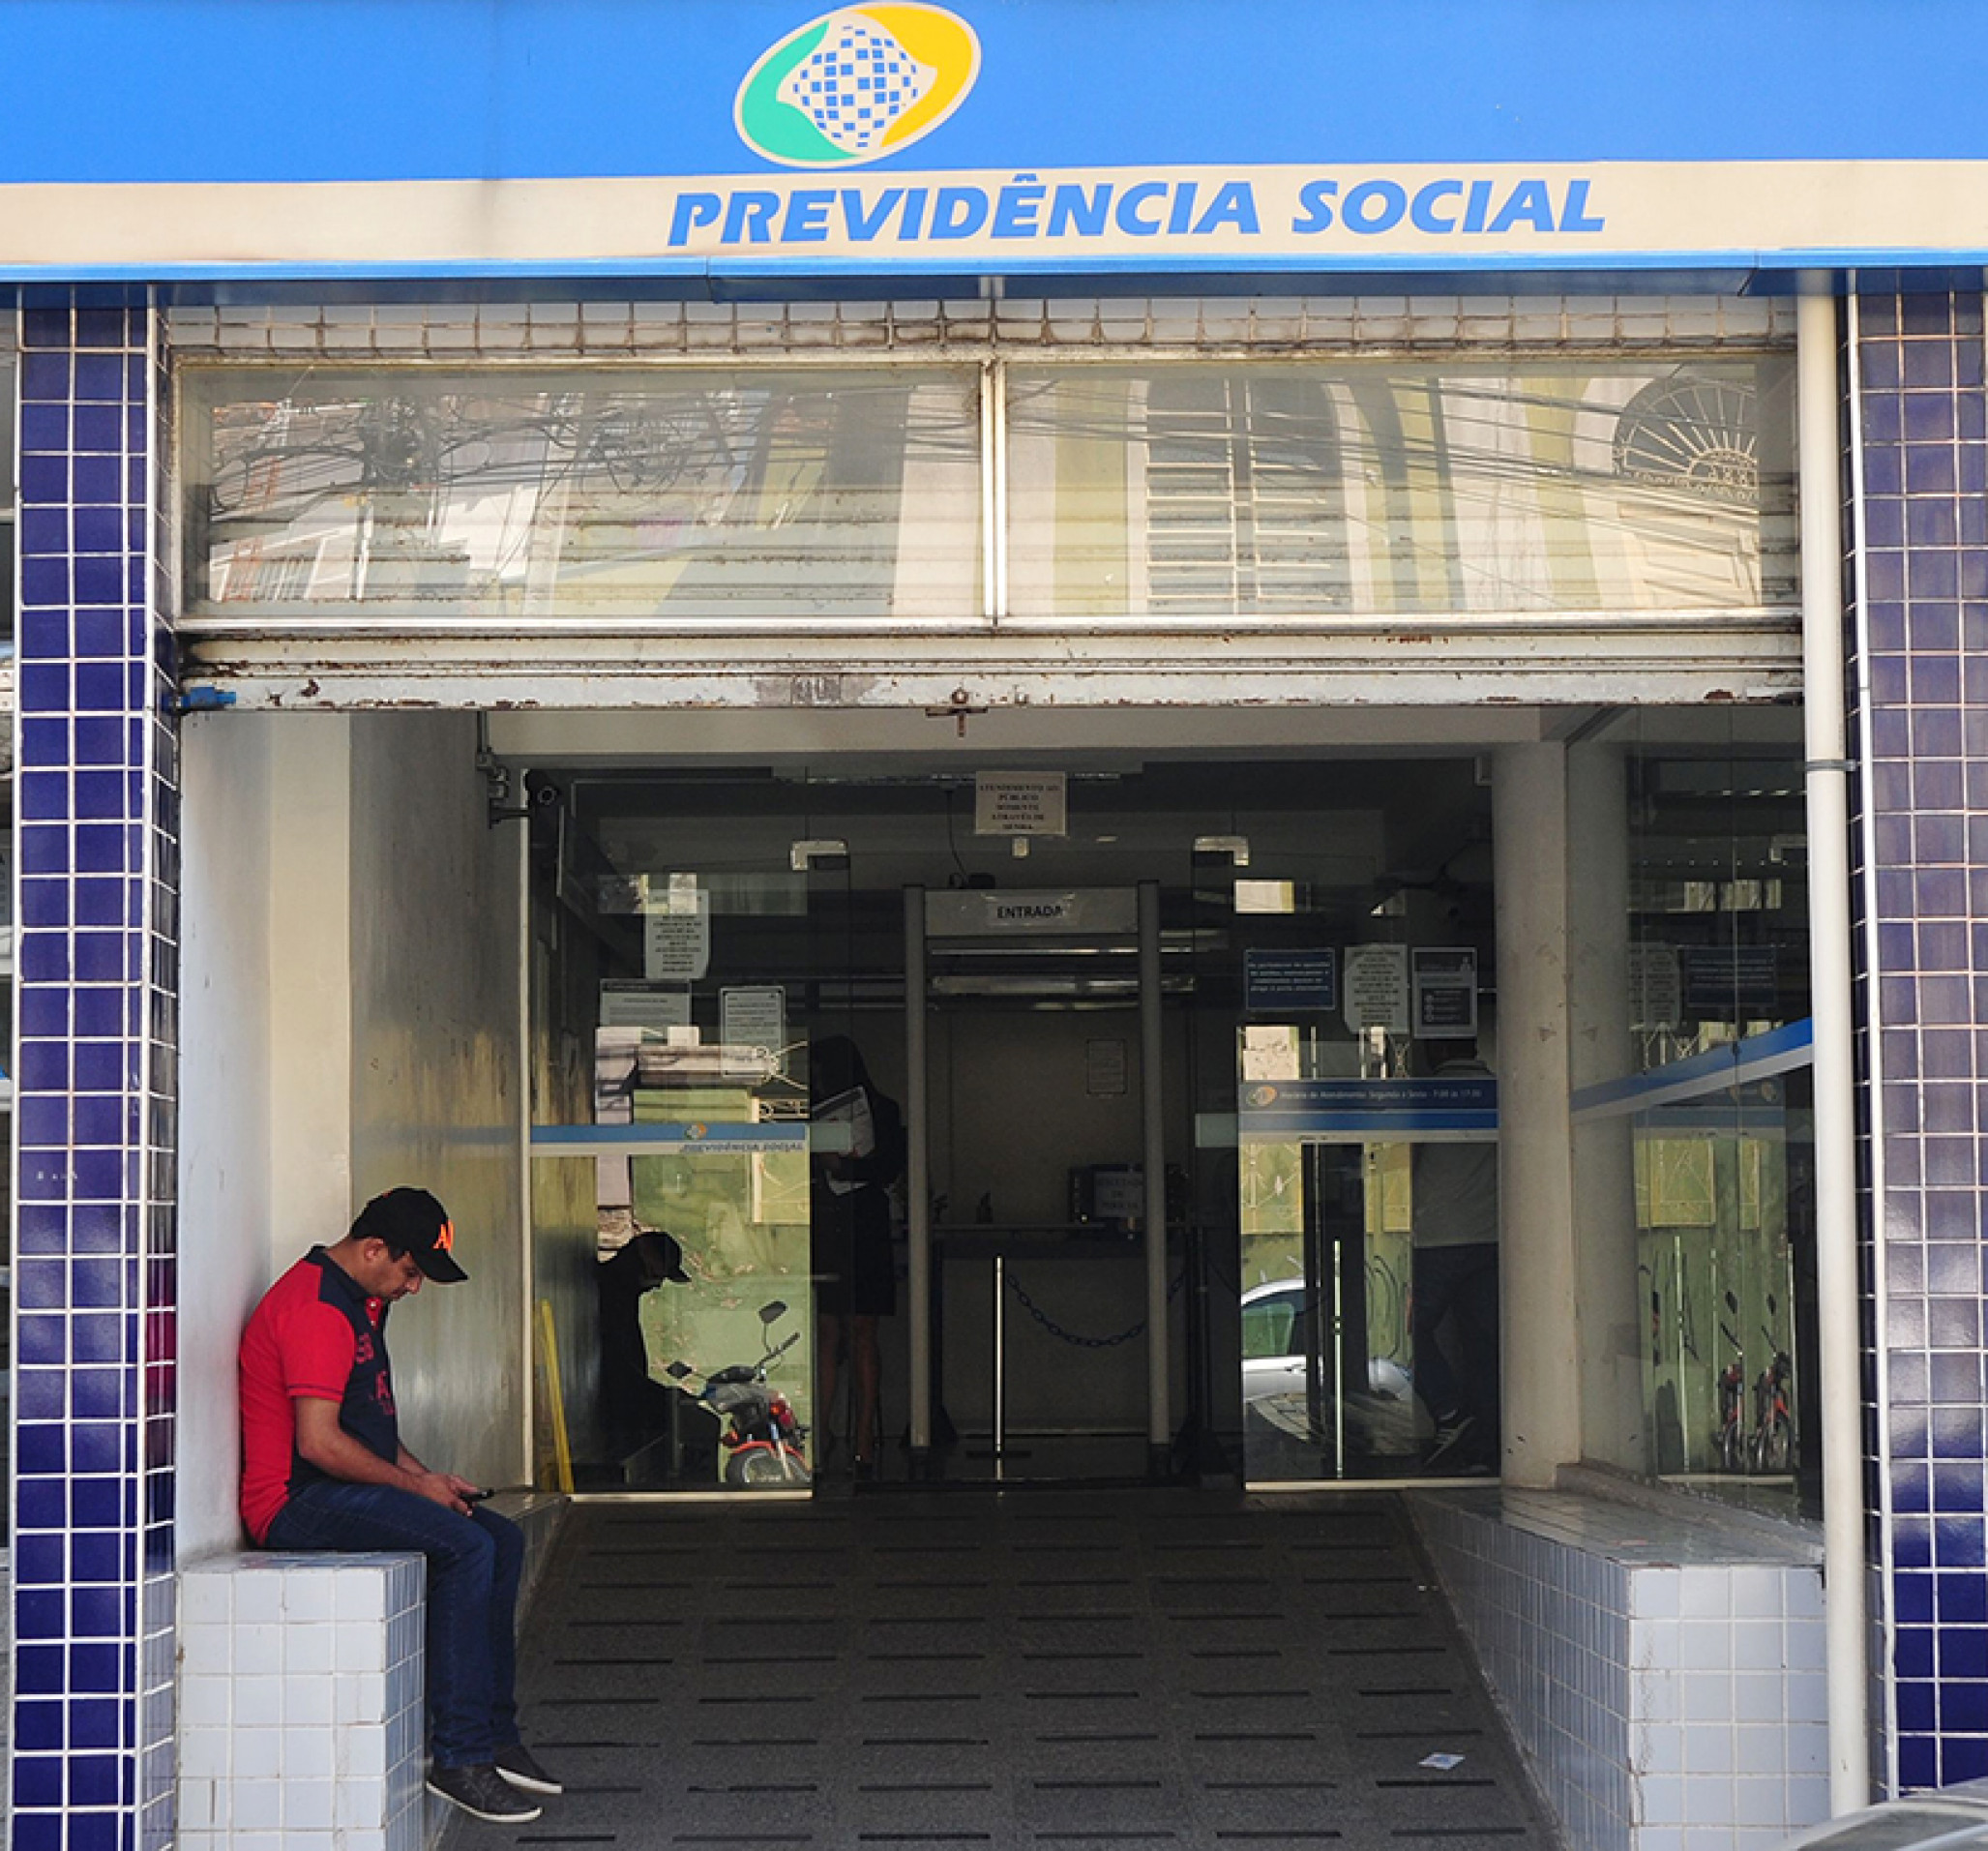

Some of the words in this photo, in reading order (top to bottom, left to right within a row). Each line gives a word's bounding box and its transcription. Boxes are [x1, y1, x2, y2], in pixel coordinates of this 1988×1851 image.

[667, 173, 1261, 248] PREVIDÊNCIA
[1291, 178, 1606, 235] SOCIAL
[996, 905, 1062, 919] ENTRADA
